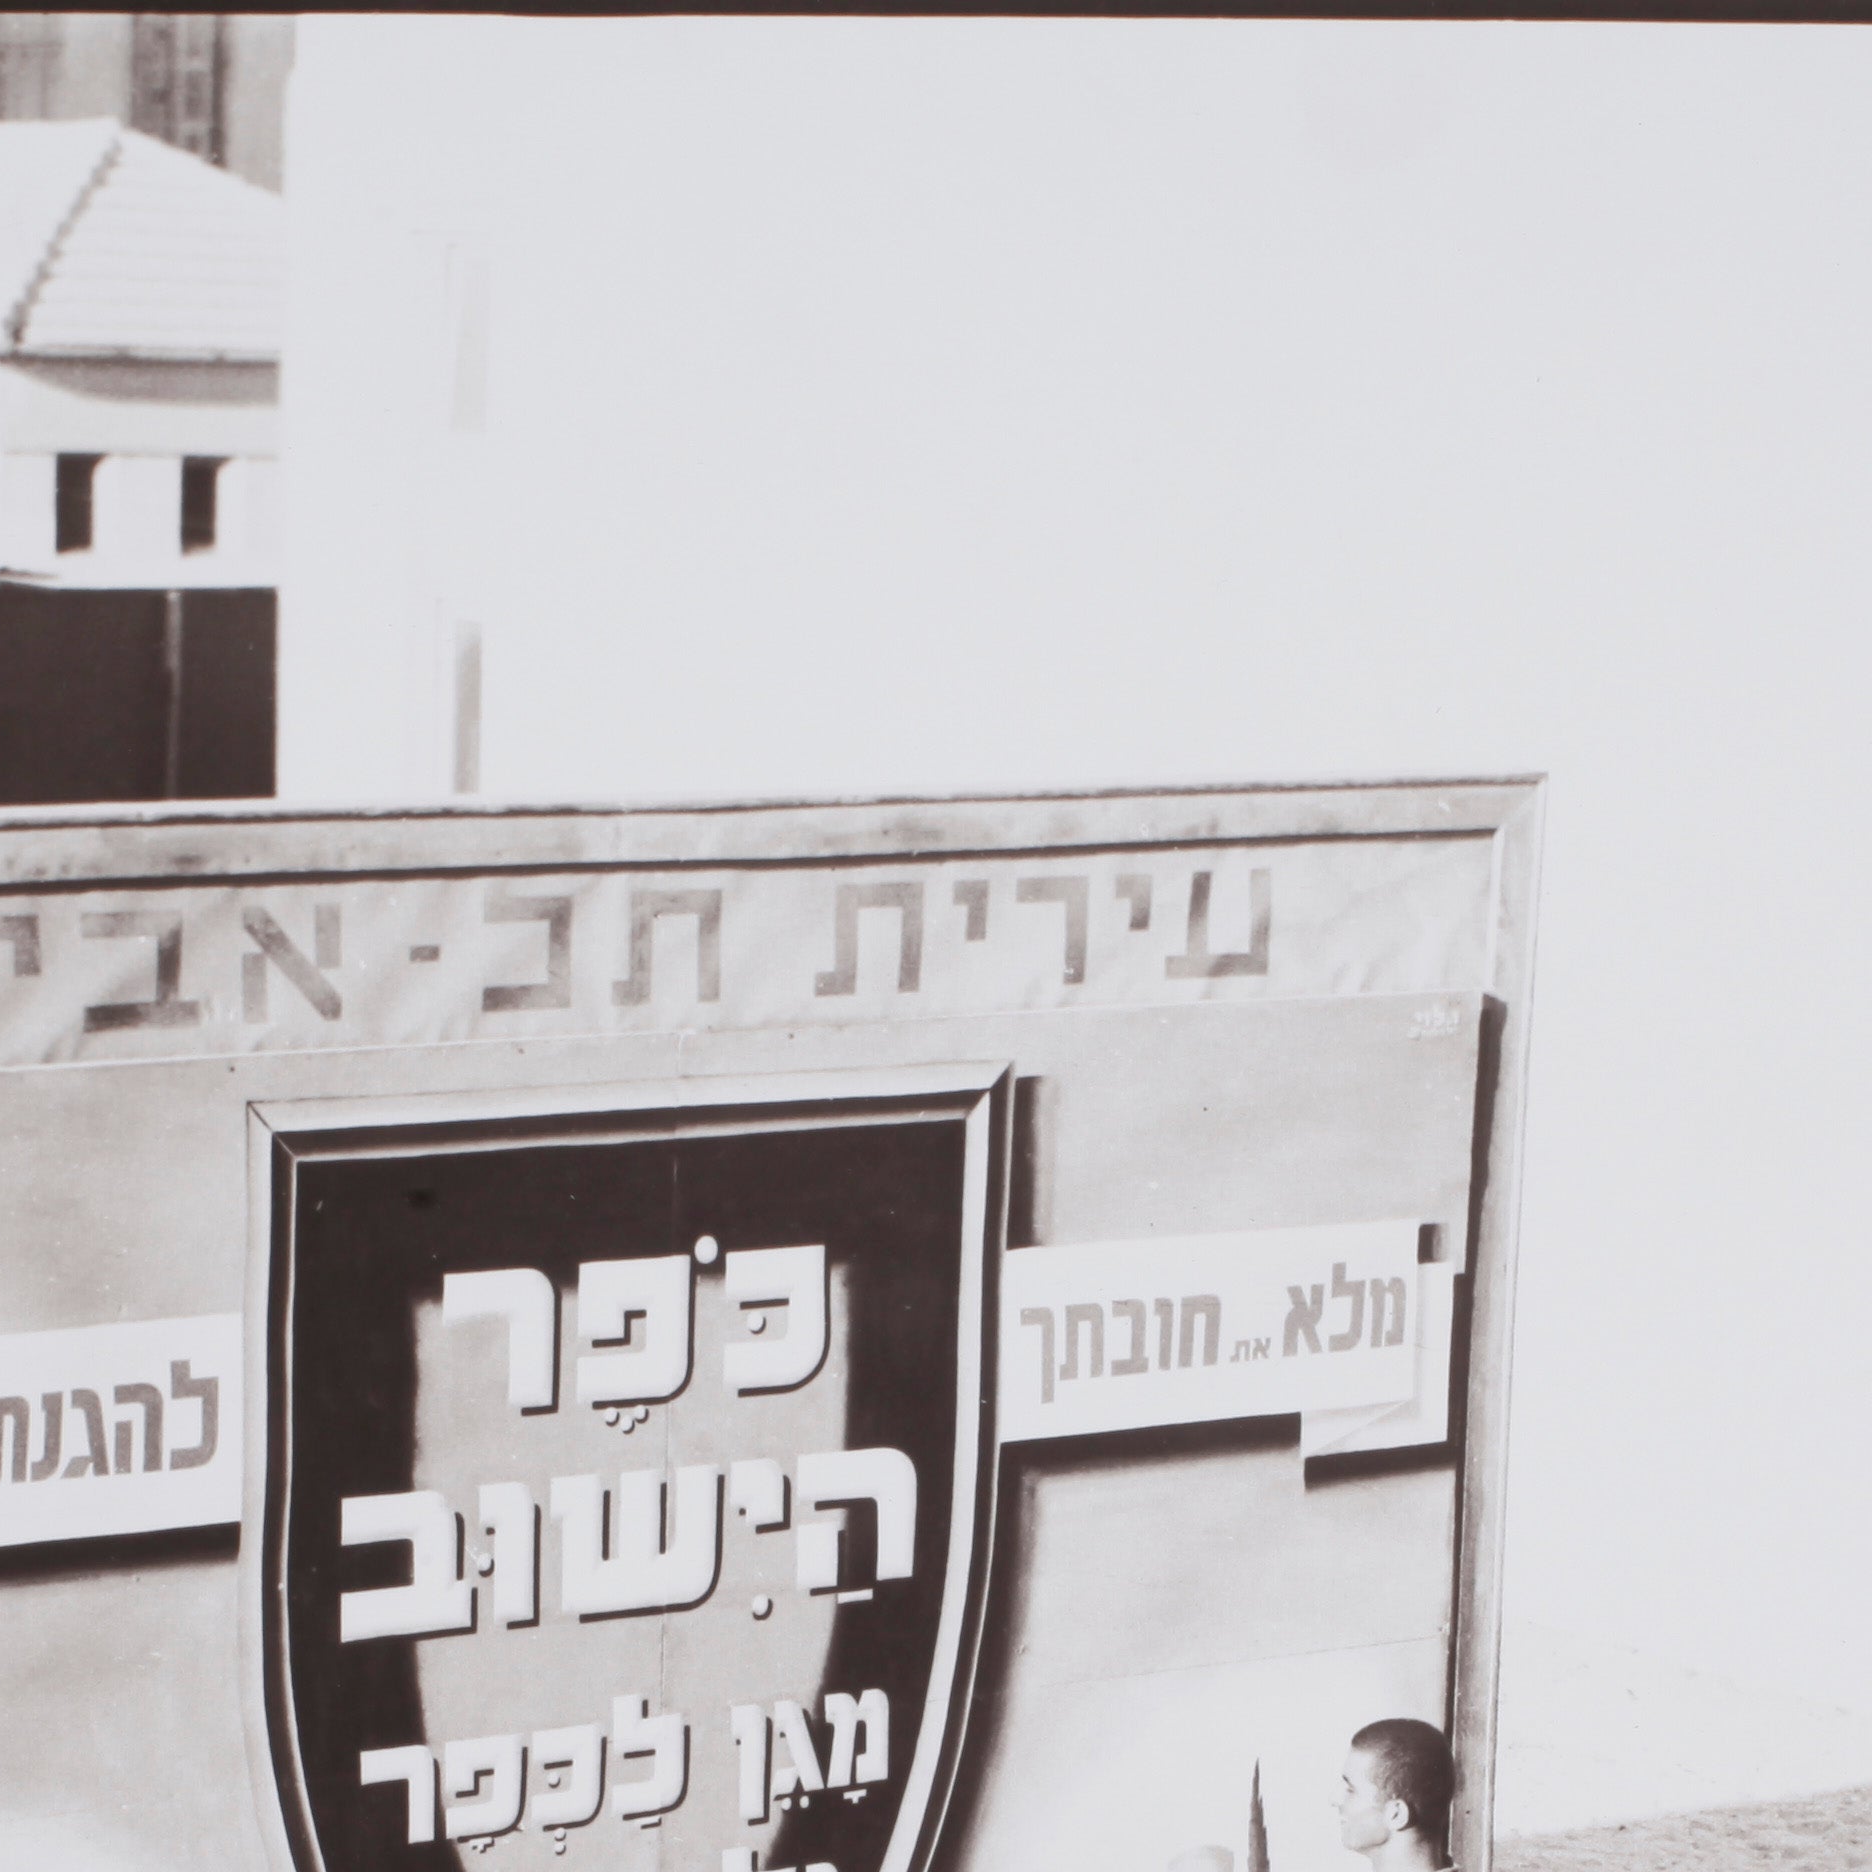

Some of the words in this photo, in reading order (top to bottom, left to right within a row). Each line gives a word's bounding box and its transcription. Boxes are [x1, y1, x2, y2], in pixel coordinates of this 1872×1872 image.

[815, 867, 1270, 997] עירית
[1020, 1294, 1221, 1404] חובתך
[1230, 1337, 1271, 1362] את
[1282, 1262, 1407, 1356] מלא
